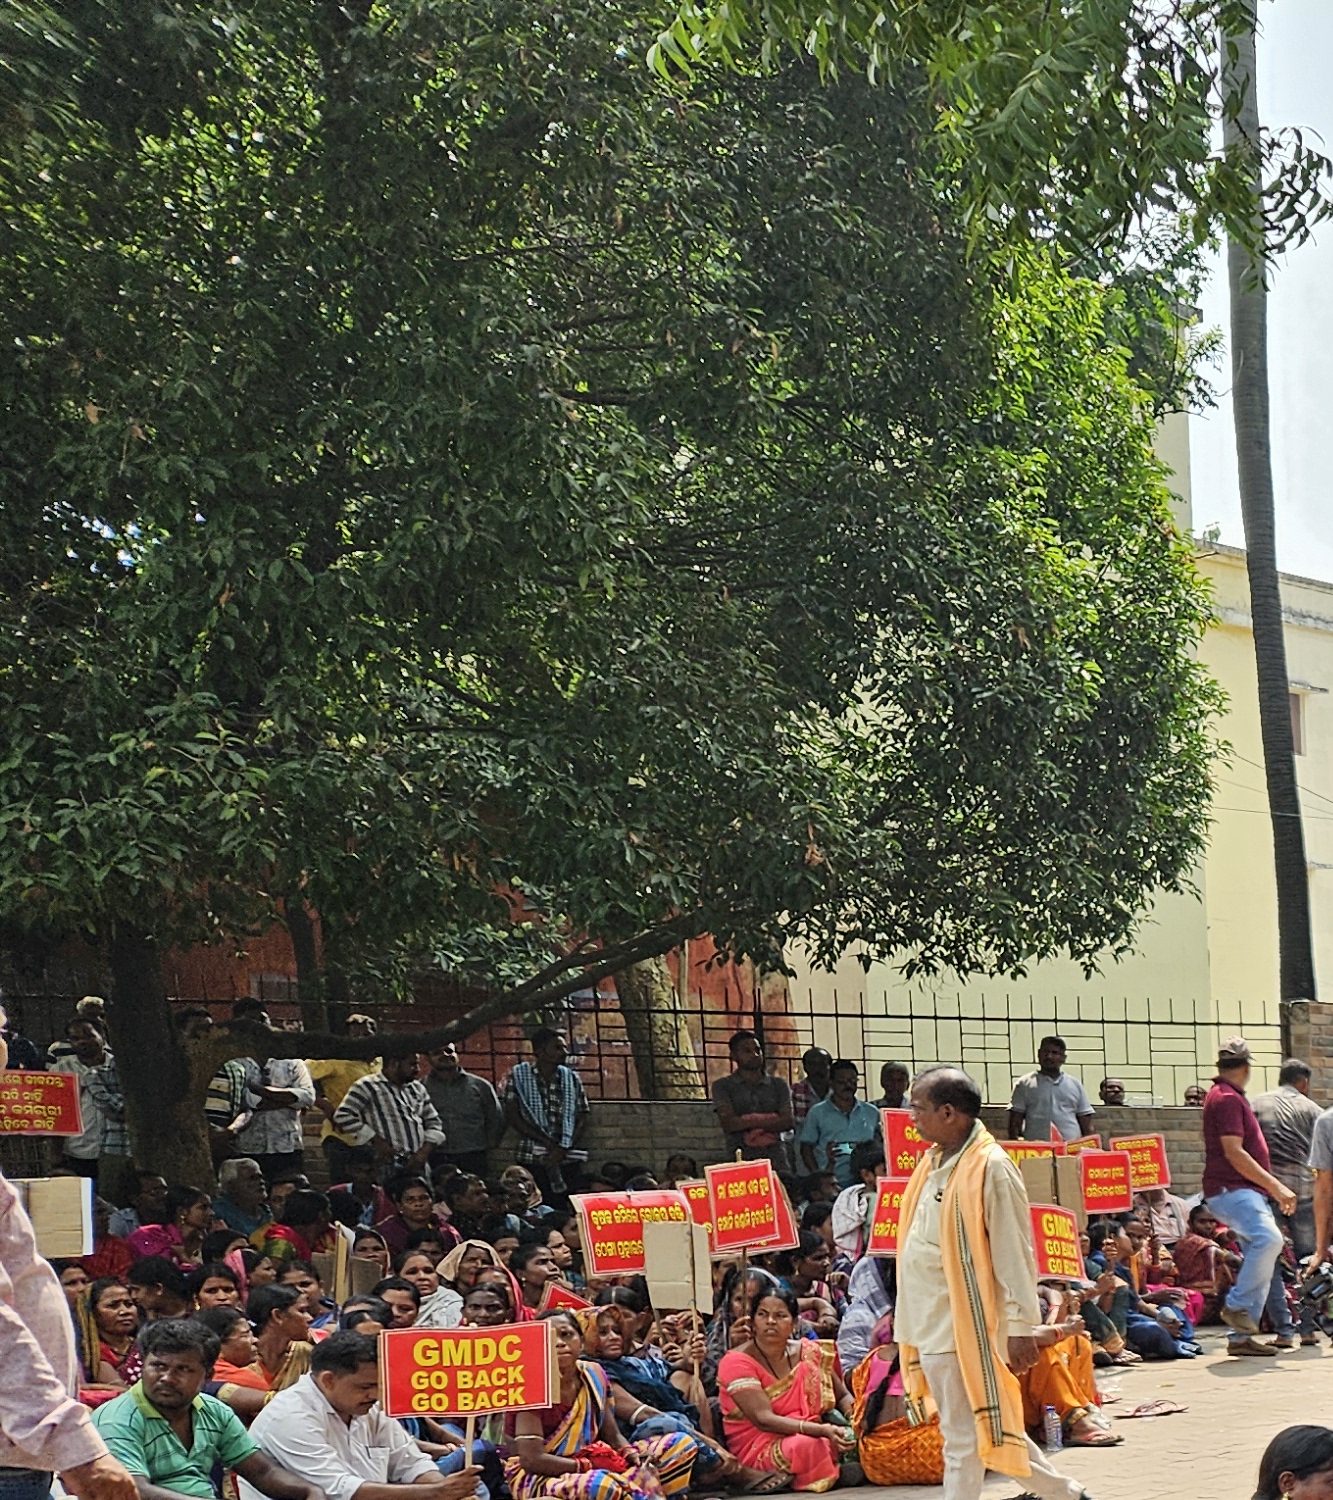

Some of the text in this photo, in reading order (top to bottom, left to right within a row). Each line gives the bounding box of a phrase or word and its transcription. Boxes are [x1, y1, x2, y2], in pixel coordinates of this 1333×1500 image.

[413, 1334, 523, 1367] GMDC
[411, 1365, 525, 1391] GO BACK
[411, 1386, 526, 1412] GO BACK
